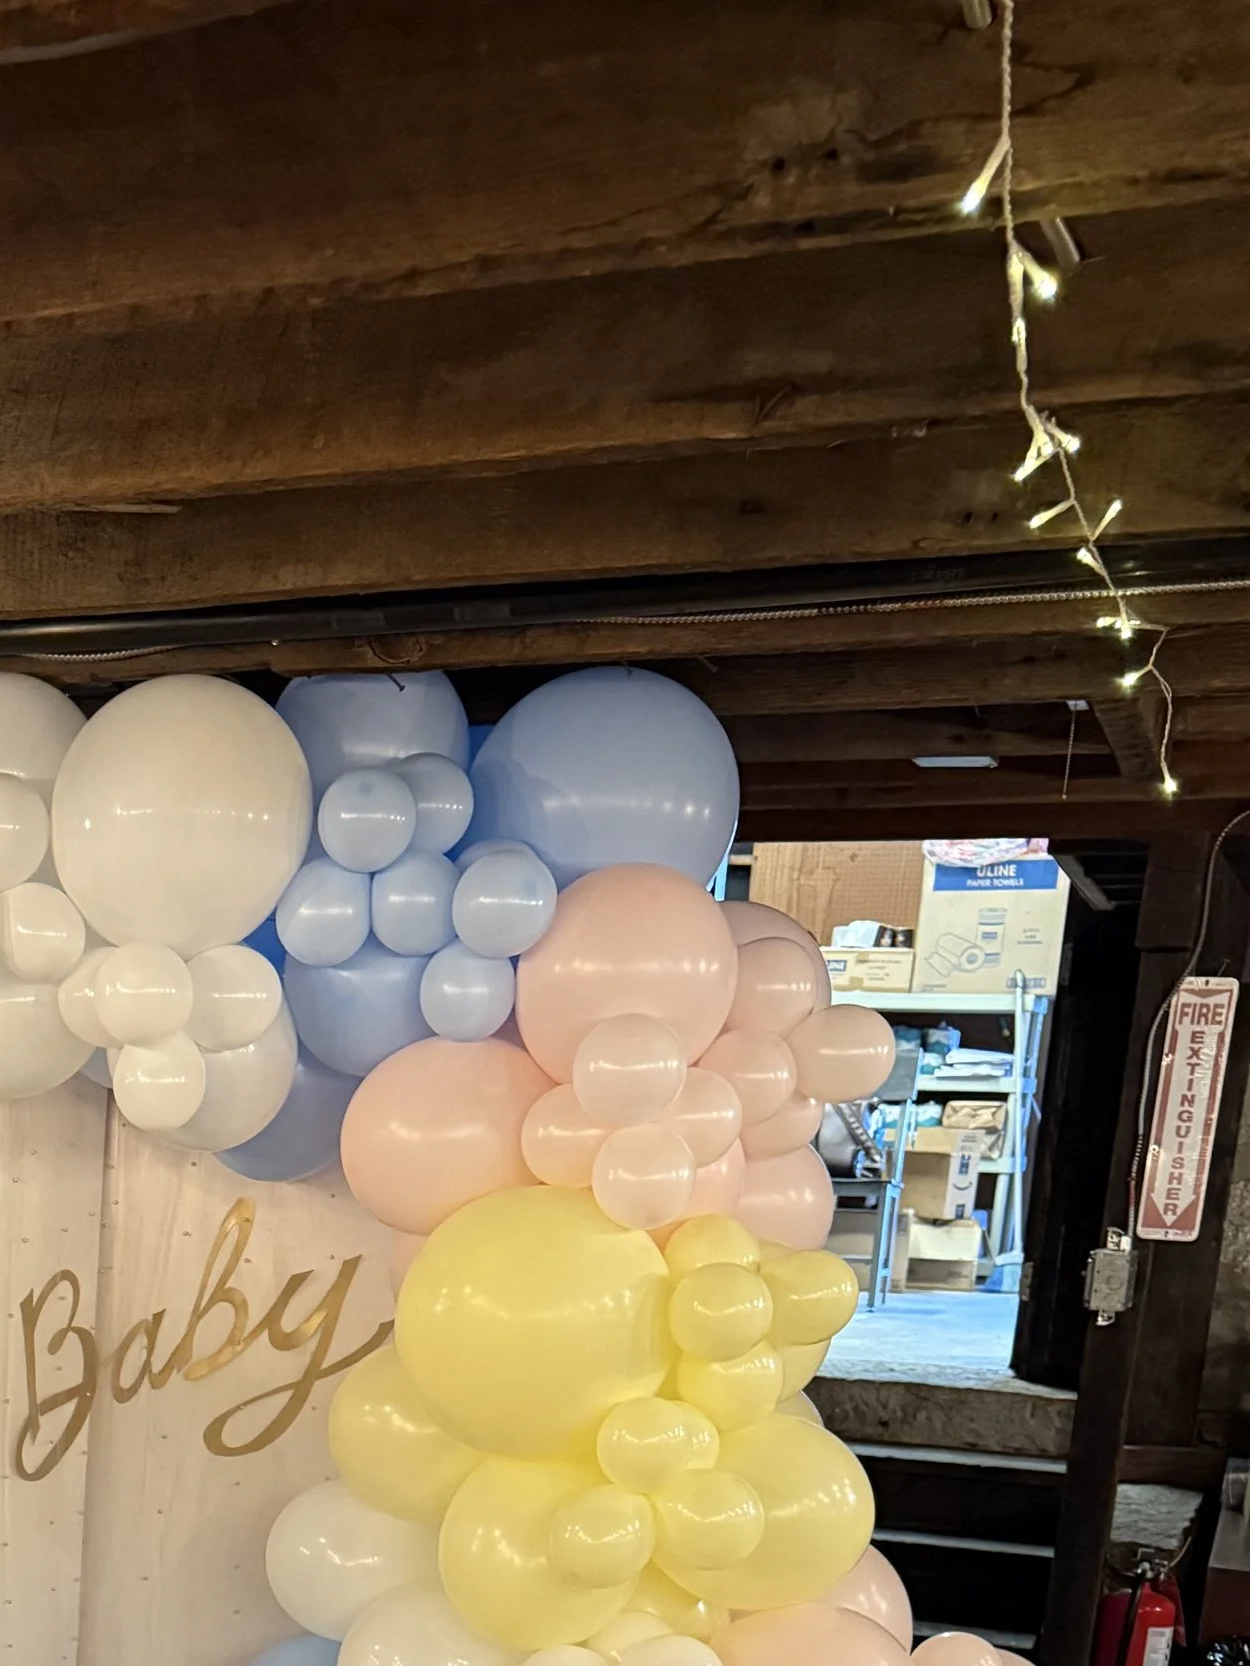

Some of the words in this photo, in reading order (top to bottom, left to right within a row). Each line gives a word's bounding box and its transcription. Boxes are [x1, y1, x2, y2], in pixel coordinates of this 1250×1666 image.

[977, 864, 1017, 877] ULINE
[966, 879, 991, 887] PAPER
[993, 878, 1024, 886] TOWELS
[1178, 1003, 1225, 1026] FIRE
[1163, 1031, 1206, 1217] EXTINGUISHER
[16, 1197, 394, 1481] Baby
